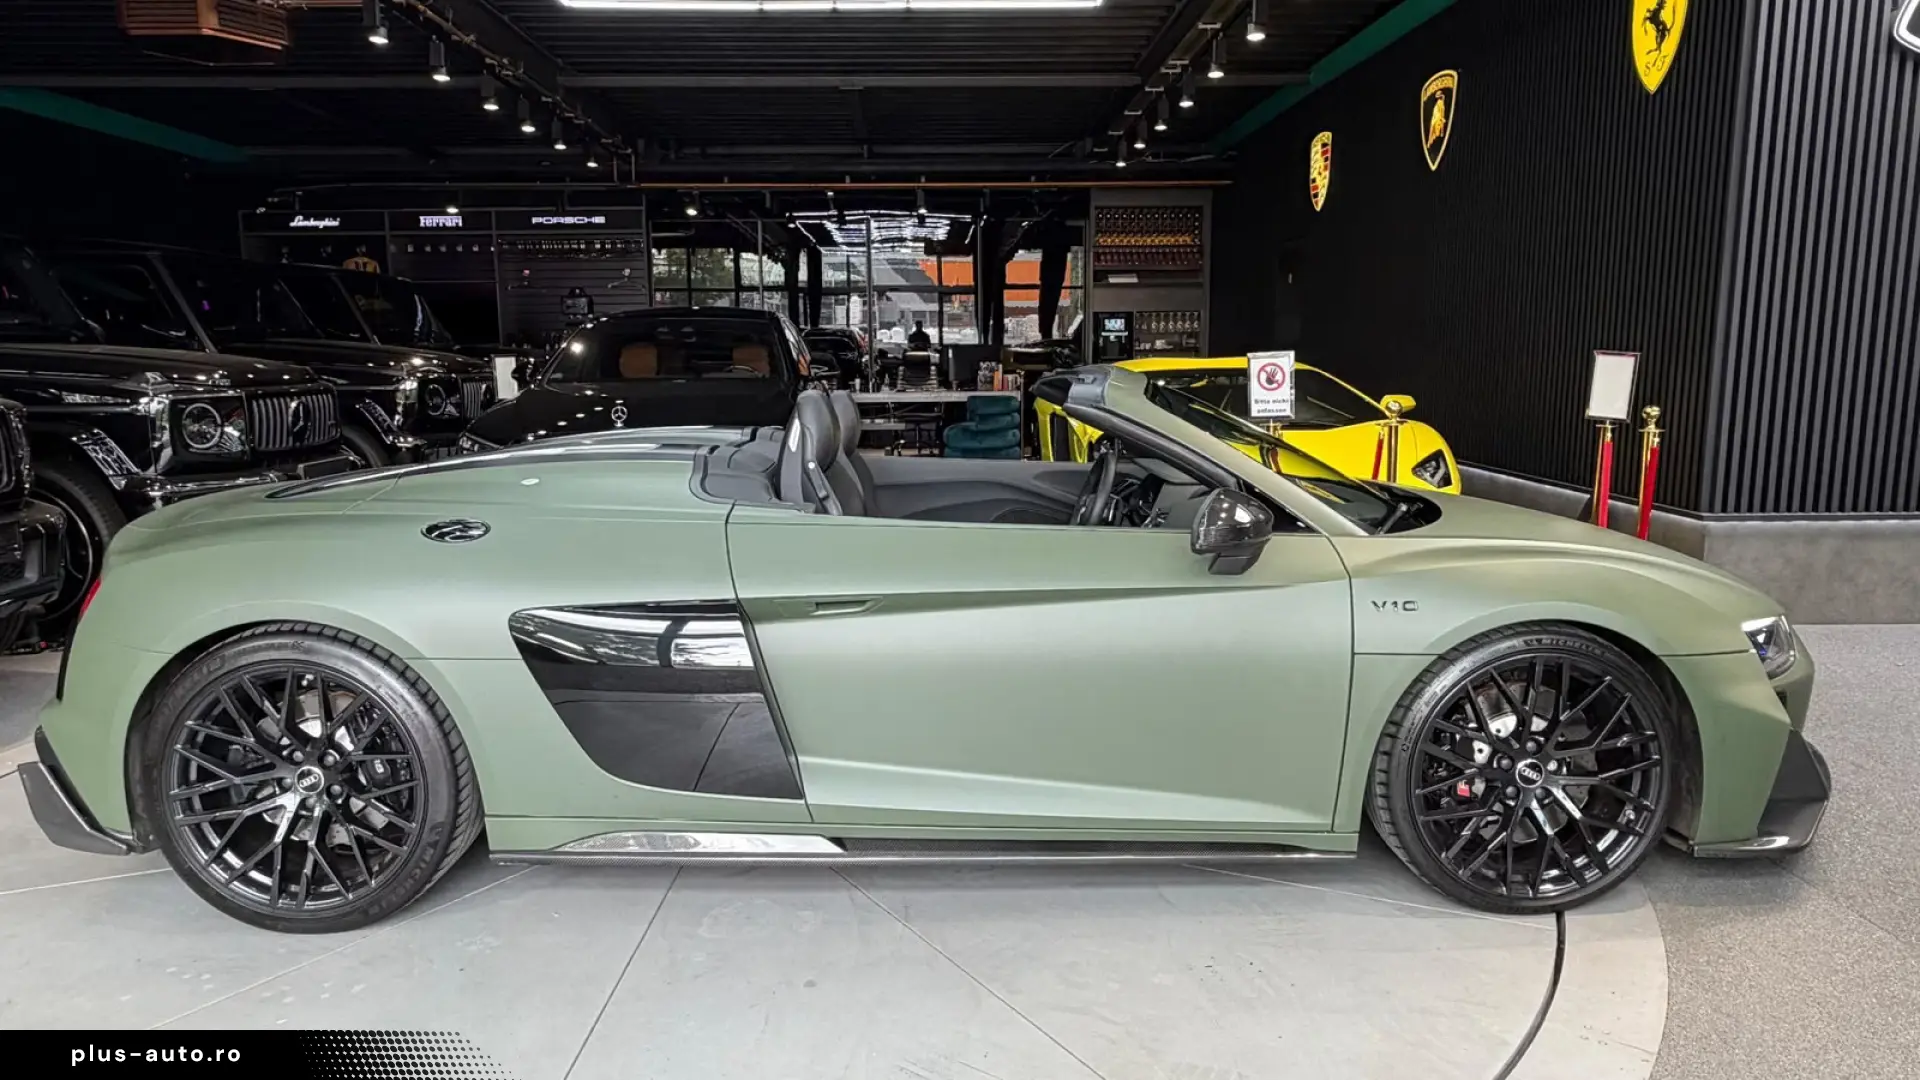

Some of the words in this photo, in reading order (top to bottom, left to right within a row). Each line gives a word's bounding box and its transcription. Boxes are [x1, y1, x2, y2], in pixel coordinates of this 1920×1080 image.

[418, 215, 463, 228] Ferrari
[531, 215, 606, 225] PORSCHE
[1369, 600, 1419, 612] V10
